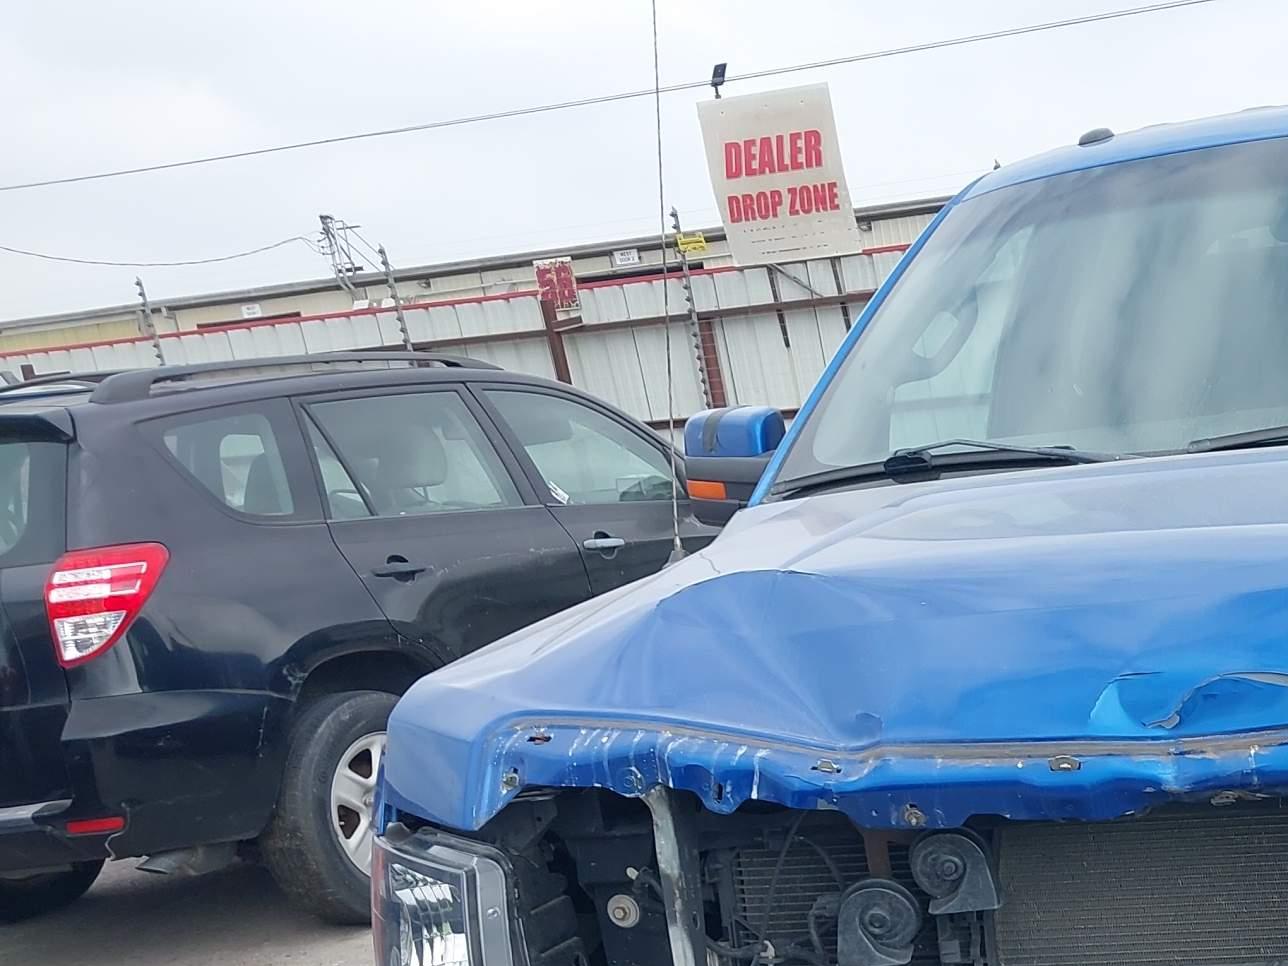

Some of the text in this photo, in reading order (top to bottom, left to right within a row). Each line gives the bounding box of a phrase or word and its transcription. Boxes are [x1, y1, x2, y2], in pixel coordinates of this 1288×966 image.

[724, 129, 823, 180] DEALER
[727, 181, 840, 224] DROP ZONE
